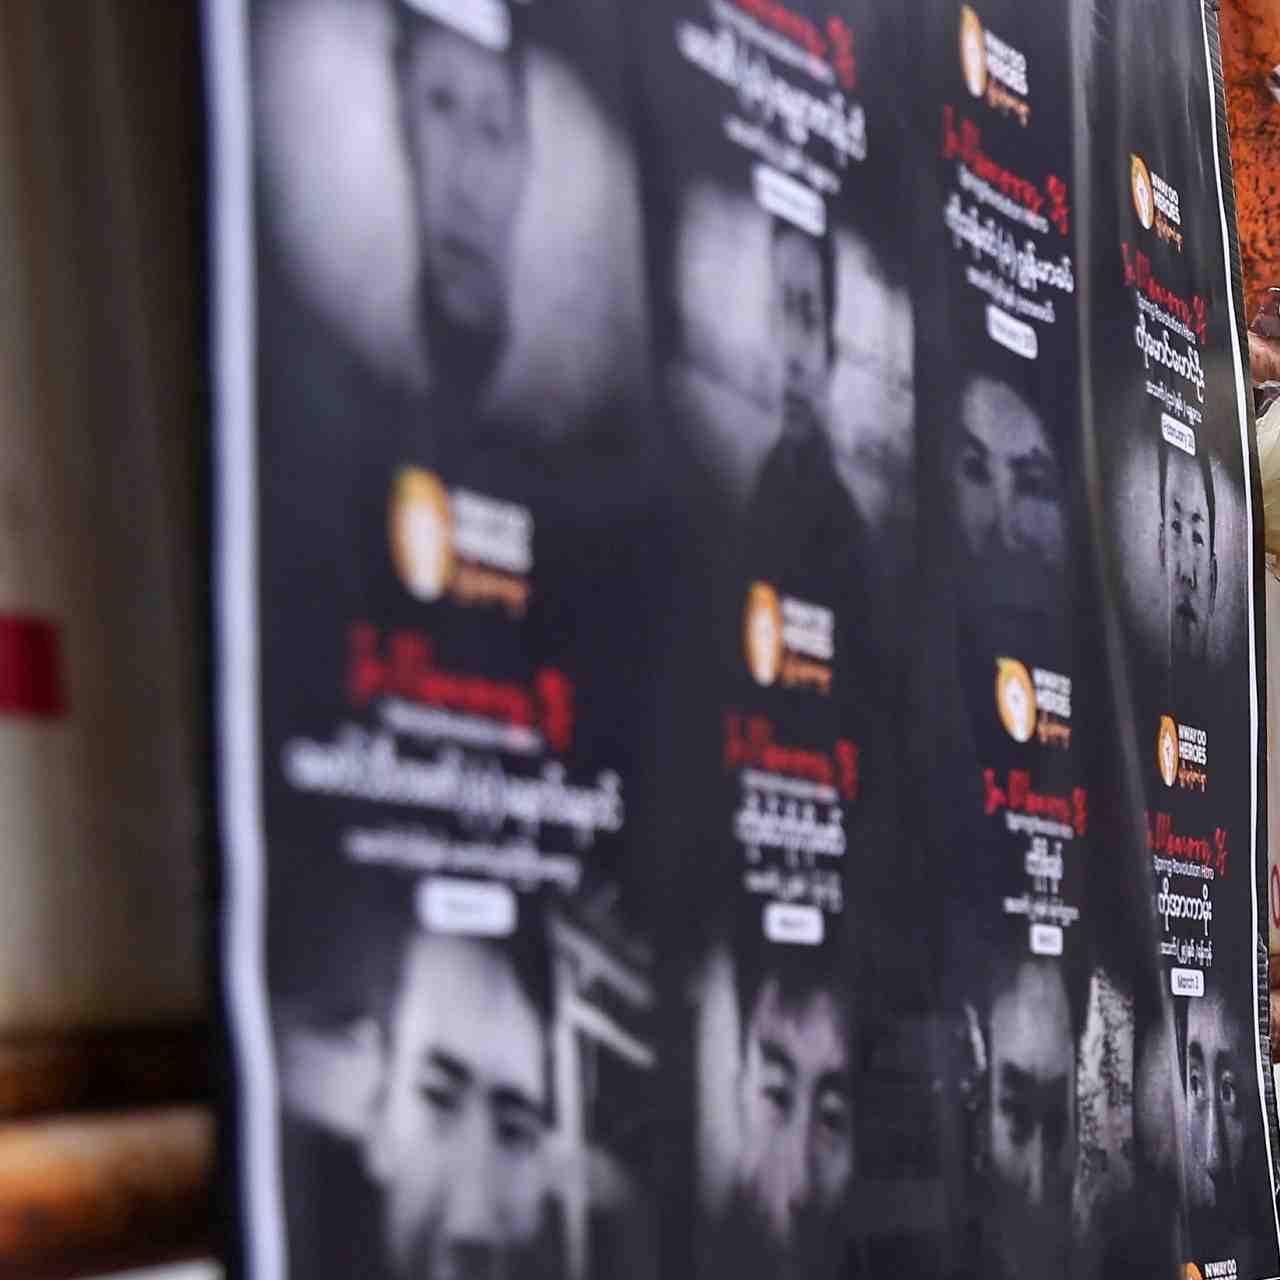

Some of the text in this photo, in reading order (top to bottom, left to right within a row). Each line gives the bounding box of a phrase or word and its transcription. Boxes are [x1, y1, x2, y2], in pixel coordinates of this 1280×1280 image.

[1178, 740, 1207, 766] HEROES
[1204, 1258, 1237, 1279] NWAY OO
